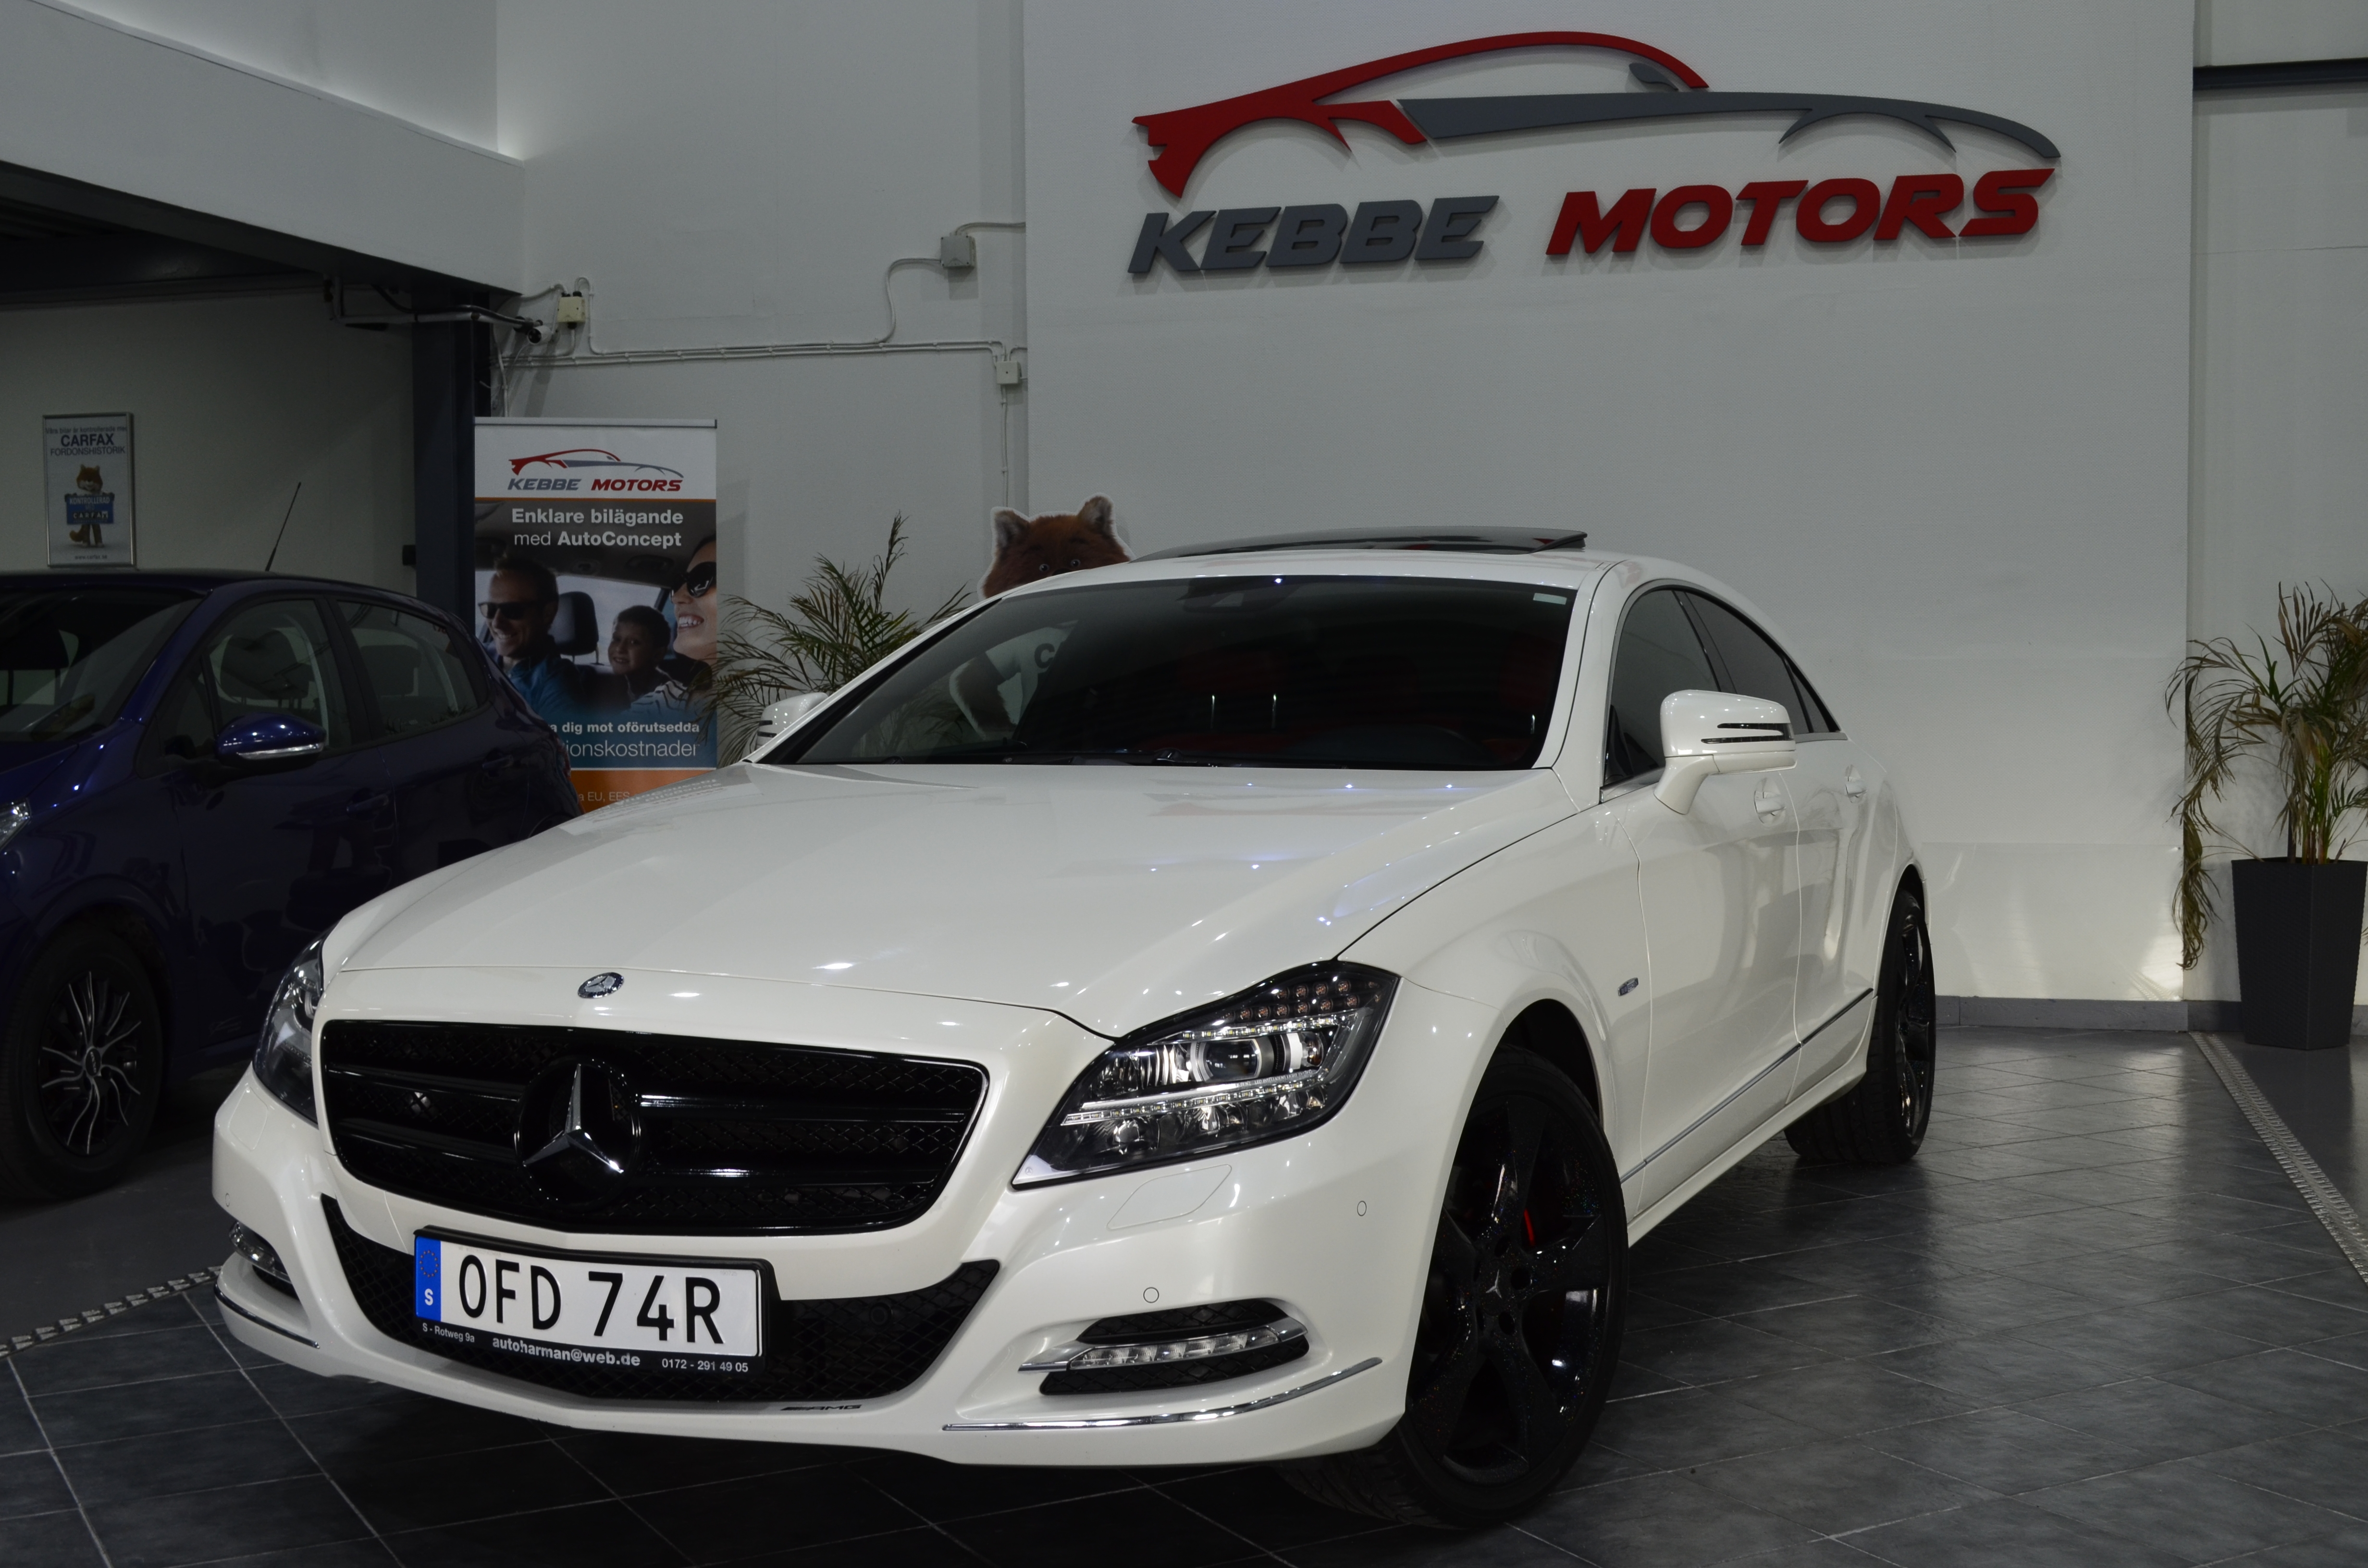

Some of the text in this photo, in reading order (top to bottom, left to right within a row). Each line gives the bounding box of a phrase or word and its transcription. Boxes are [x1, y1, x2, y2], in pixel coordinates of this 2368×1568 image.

[1127, 168, 2057, 273] KEBBE MOTORS
[61, 433, 114, 447] CARFAX
[50, 446, 125, 456] FORDONSHISTORIK
[508, 478, 683, 491] KEBBE MOTORS
[70, 496, 110, 504] KONTROLLERAD
[74, 511, 108, 519] CARFAX
[512, 508, 683, 527] Enklare bilägande
[514, 532, 681, 549] med AutoConcept
[562, 722, 582, 735] dig
[587, 723, 613, 733] mot
[617, 722, 700, 733] oförutsedda
[588, 792, 605, 802] EU,
[424, 1288, 433, 1306] S
[459, 1254, 724, 1345] OFD 74R
[422, 1323, 428, 1332] S
[435, 1325, 463, 1342] Rotweg
[465, 1333, 475, 1343] 9a
[493, 1336, 641, 1367] autoharman@web.de
[662, 1359, 687, 1370] 0172
[697, 1360, 716, 1371] 291
[720, 1361, 733, 1372] 49
[736, 1362, 748, 1372] 05
